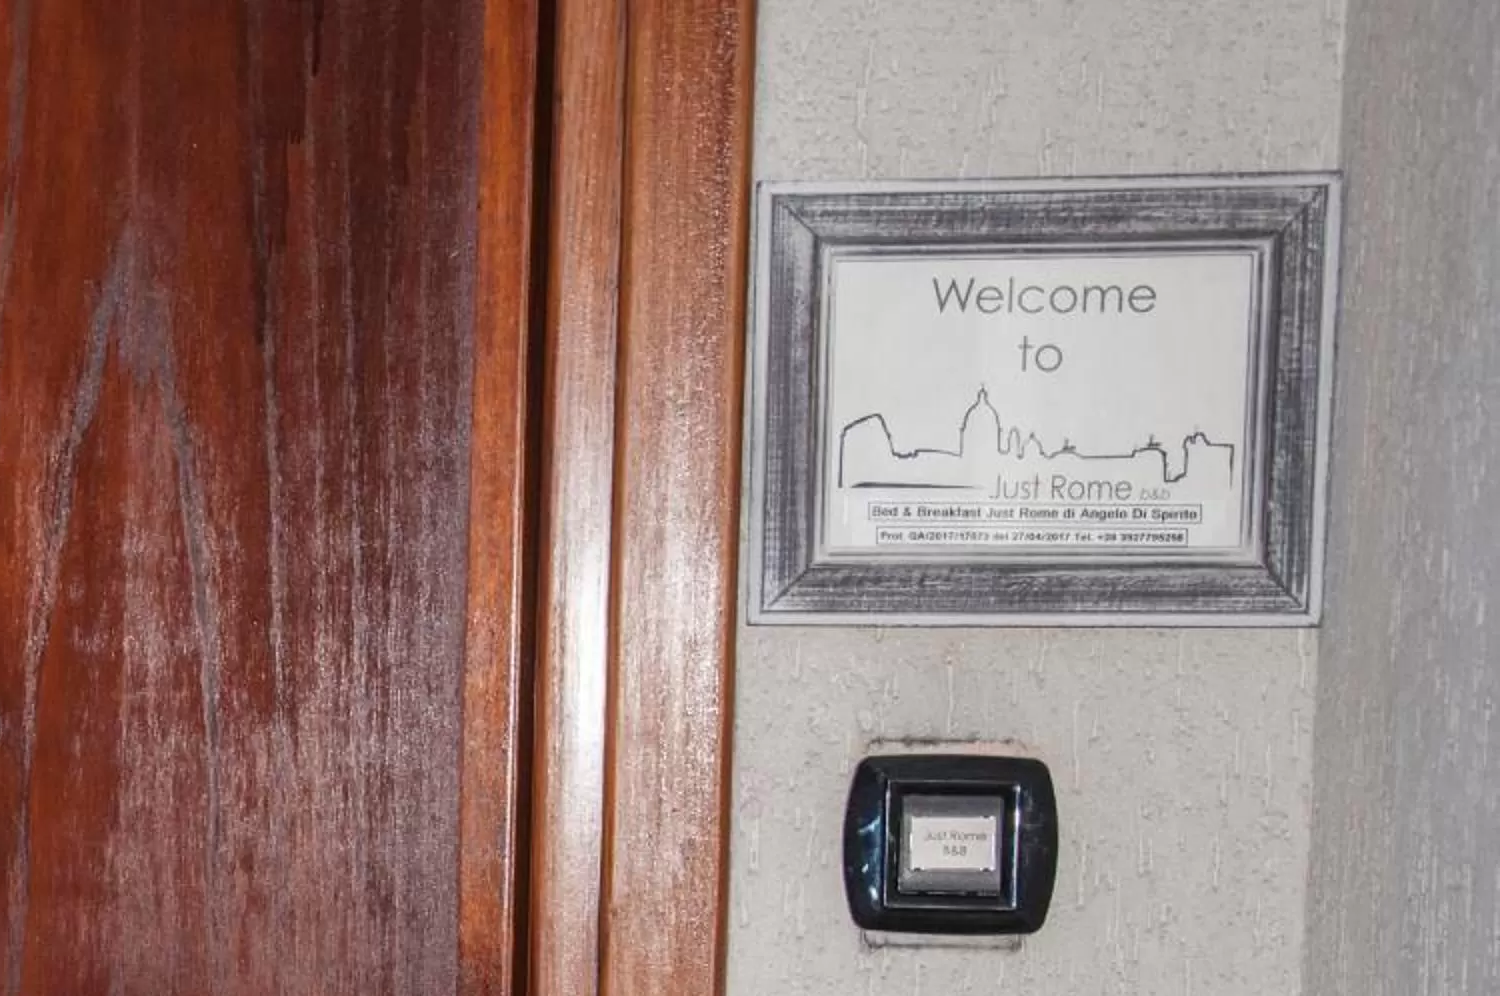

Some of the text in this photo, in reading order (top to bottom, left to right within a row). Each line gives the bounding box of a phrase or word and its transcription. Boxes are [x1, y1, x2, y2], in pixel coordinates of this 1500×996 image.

[932, 276, 1157, 314] Welcome
[1017, 335, 1063, 373] to
[988, 472, 1041, 500] Just
[1051, 474, 1133, 501] Rome
[871, 505, 899, 517] Bed
[902, 506, 912, 517] &
[916, 505, 982, 518] Breakfast
[986, 506, 1014, 518] Just
[1018, 507, 1059, 519] Rome
[1062, 507, 1076, 519] di
[1080, 507, 1128, 521] Angelo
[1132, 508, 1148, 519] Di
